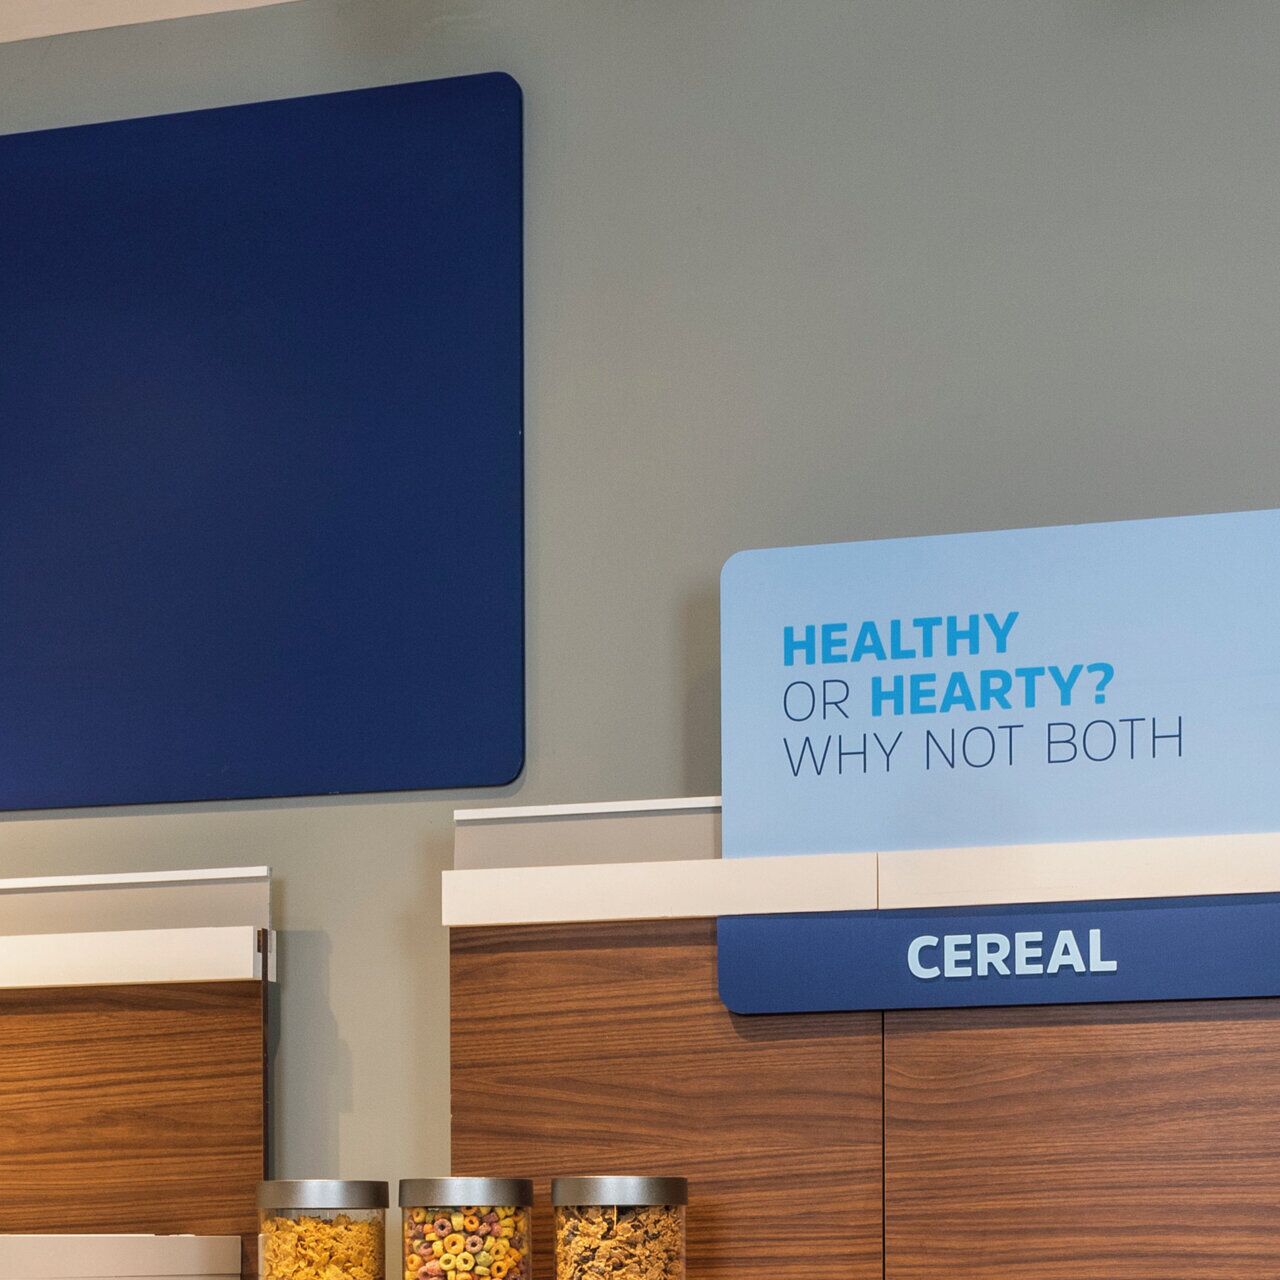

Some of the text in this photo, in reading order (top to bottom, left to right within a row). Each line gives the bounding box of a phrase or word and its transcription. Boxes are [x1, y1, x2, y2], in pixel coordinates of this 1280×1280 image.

[783, 611, 1019, 666] HEALTHY
[783, 662, 1115, 722] OR HEARTY?
[783, 716, 1184, 777] WHY NOT BOTH
[907, 929, 1118, 980] CEREAL
